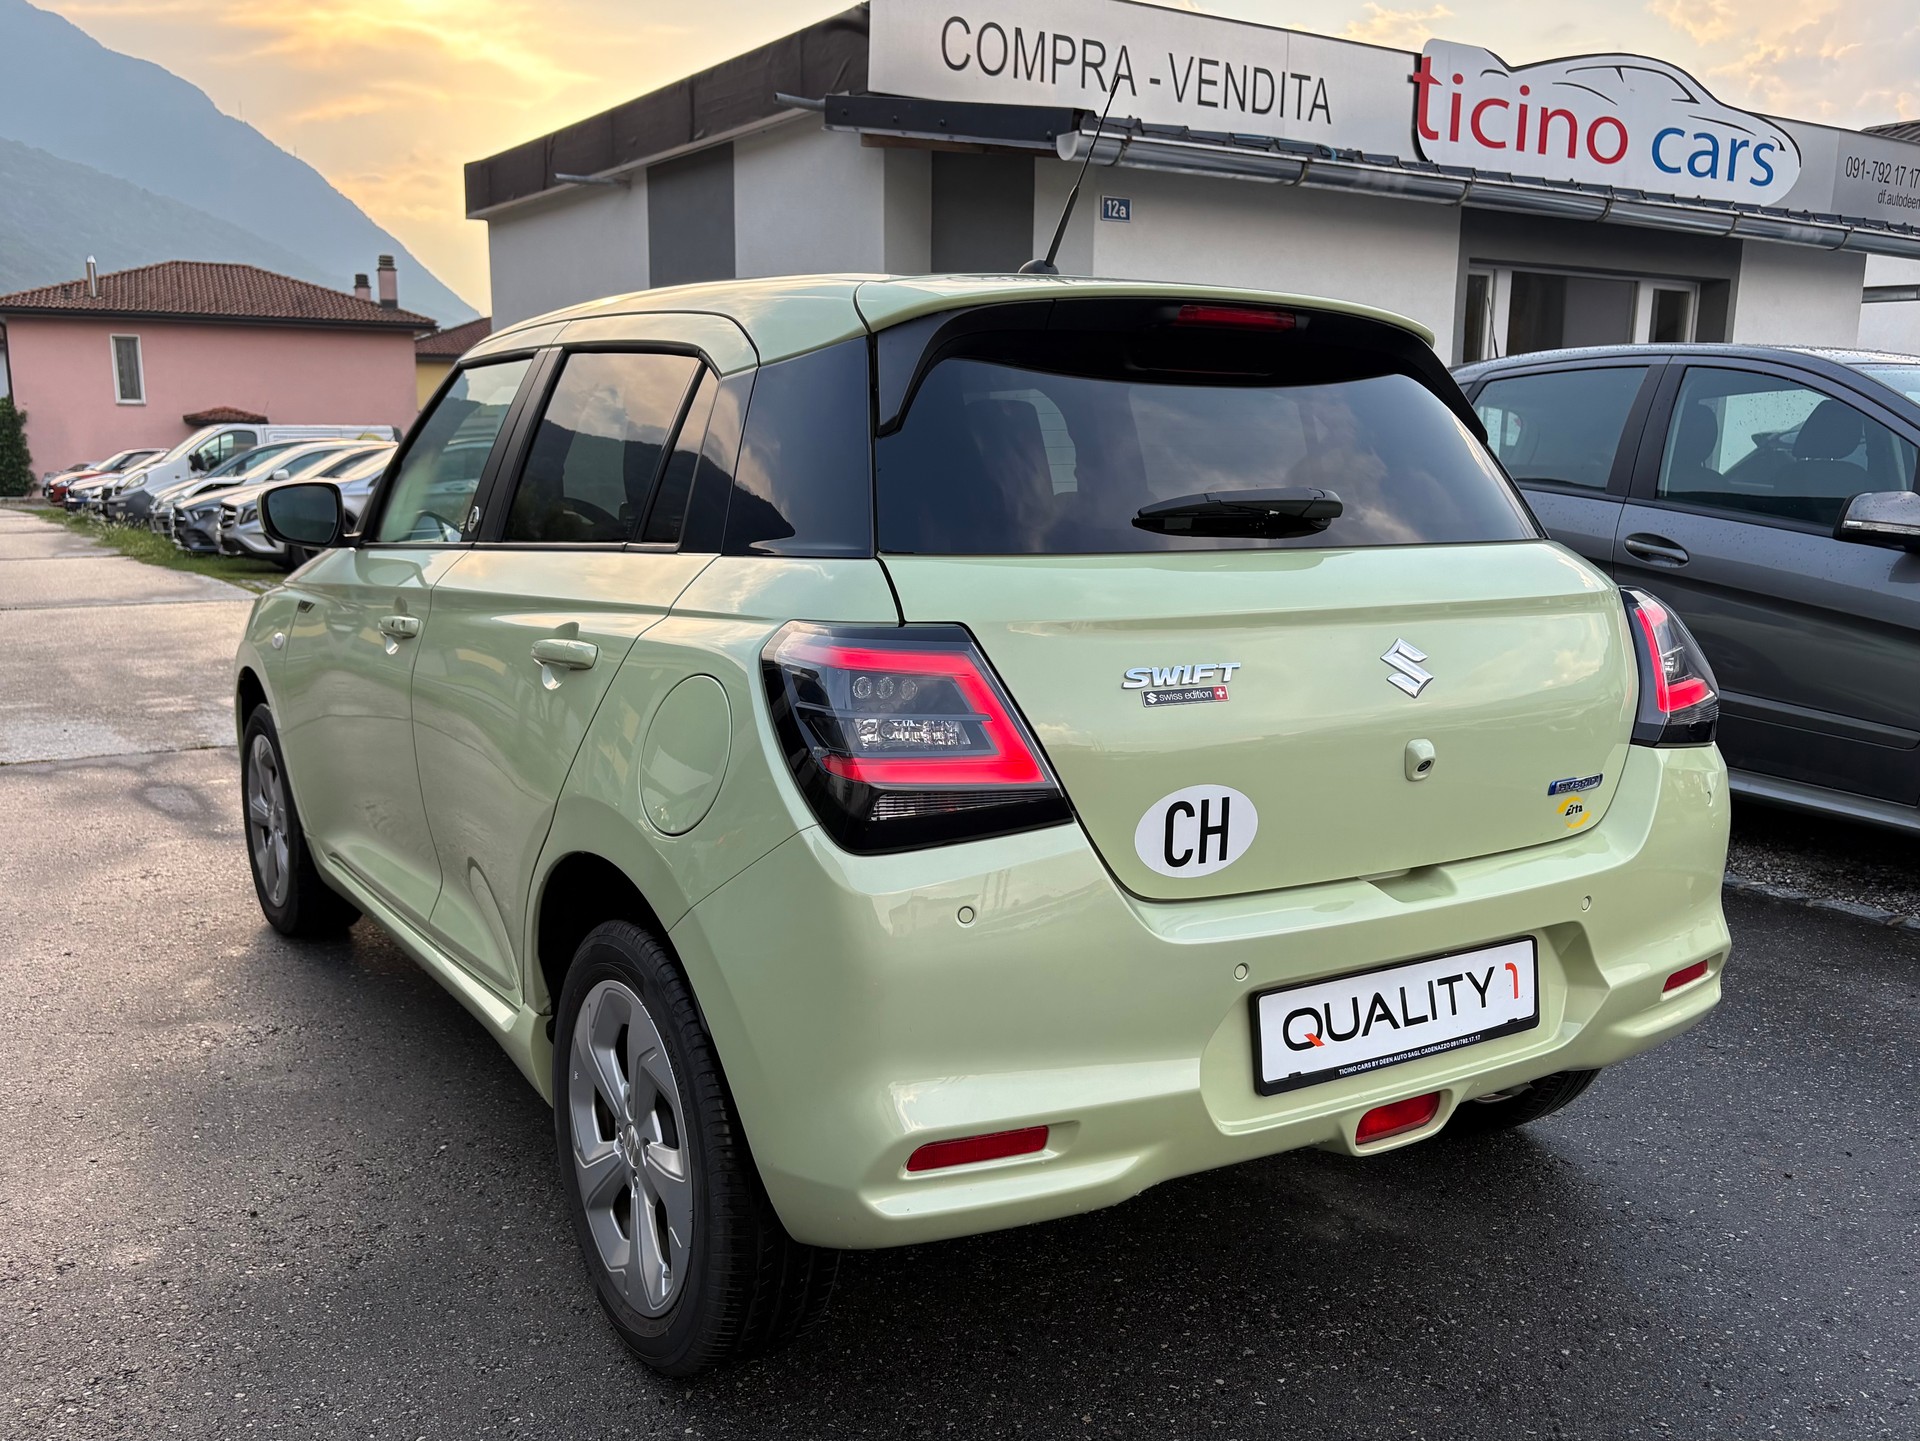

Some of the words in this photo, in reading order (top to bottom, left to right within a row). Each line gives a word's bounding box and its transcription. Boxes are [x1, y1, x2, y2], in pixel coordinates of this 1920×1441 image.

[940, 16, 1137, 96] COMPRA
[1412, 56, 1629, 165] ticino
[1651, 126, 1776, 187] cars
[1845, 156, 1892, 184] 091-792
[1895, 165, 1907, 186] 17
[1909, 168, 1920, 189] 17
[1106, 200, 1127, 218] 12a
[1121, 662, 1241, 689] SWIFT
[1159, 692, 1183, 702] swiss
[1184, 689, 1213, 700] edition
[1163, 796, 1231, 868] CH
[1282, 966, 1496, 1052] QUALITY
[1338, 1066, 1357, 1076] TICINO
[1357, 1062, 1372, 1072] CARS
[1371, 1060, 1379, 1068] BY
[1379, 1057, 1394, 1066] DEEN
[1394, 1053, 1408, 1062] AUTO
[1420, 1042, 1451, 1055] CADENAZZO
